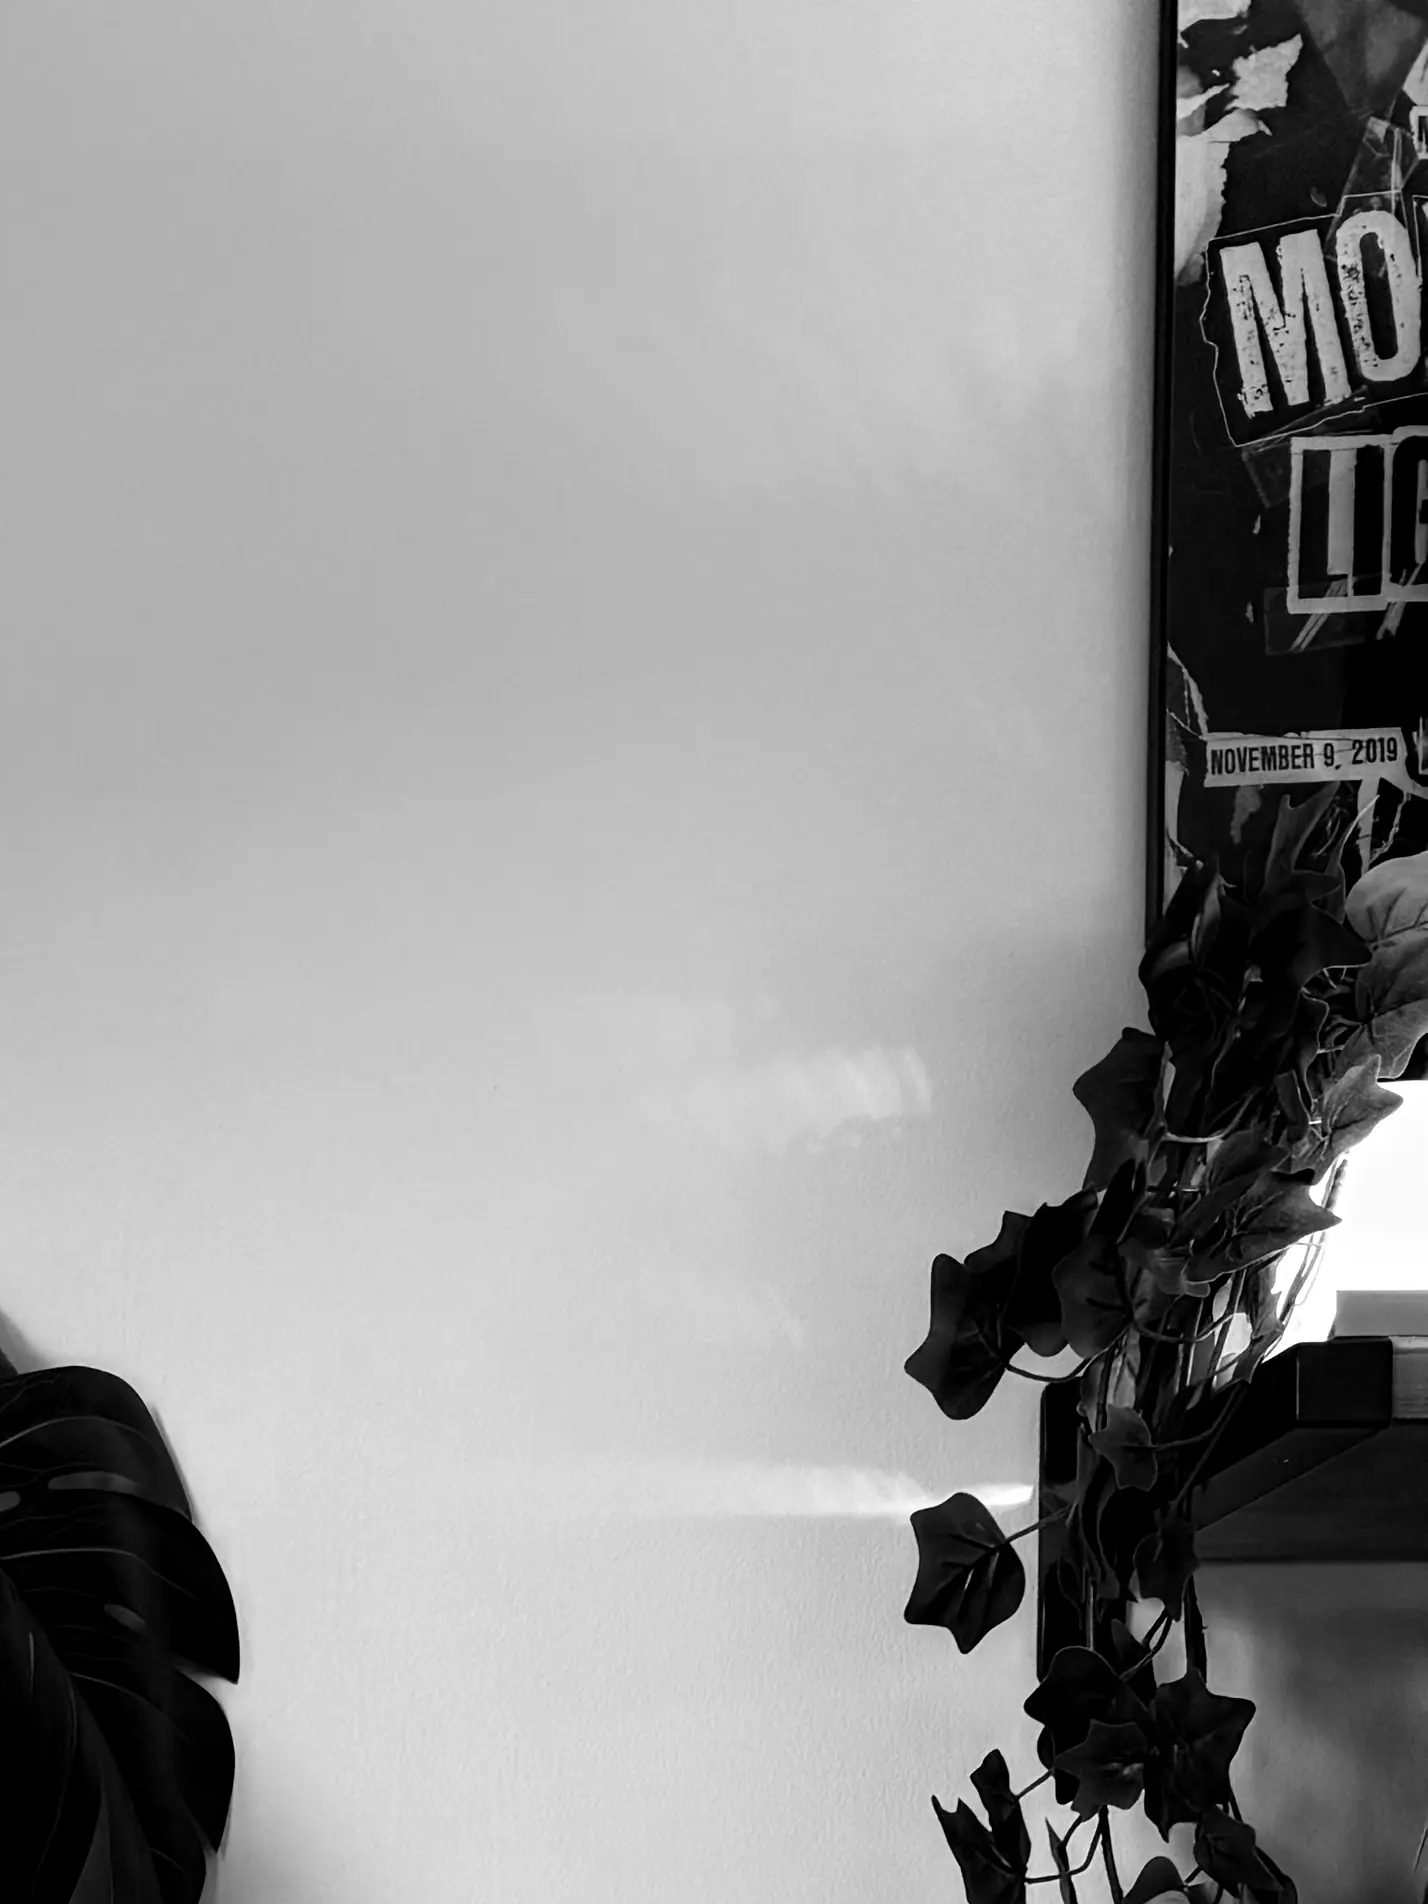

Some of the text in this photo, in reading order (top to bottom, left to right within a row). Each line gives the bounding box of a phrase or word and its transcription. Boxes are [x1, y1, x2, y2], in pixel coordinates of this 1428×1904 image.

[1219, 203, 1428, 419] MO
[1210, 743, 1315, 776] NOVEMBER
[1323, 742, 1342, 770] 9,
[1351, 736, 1398, 765] 2019
